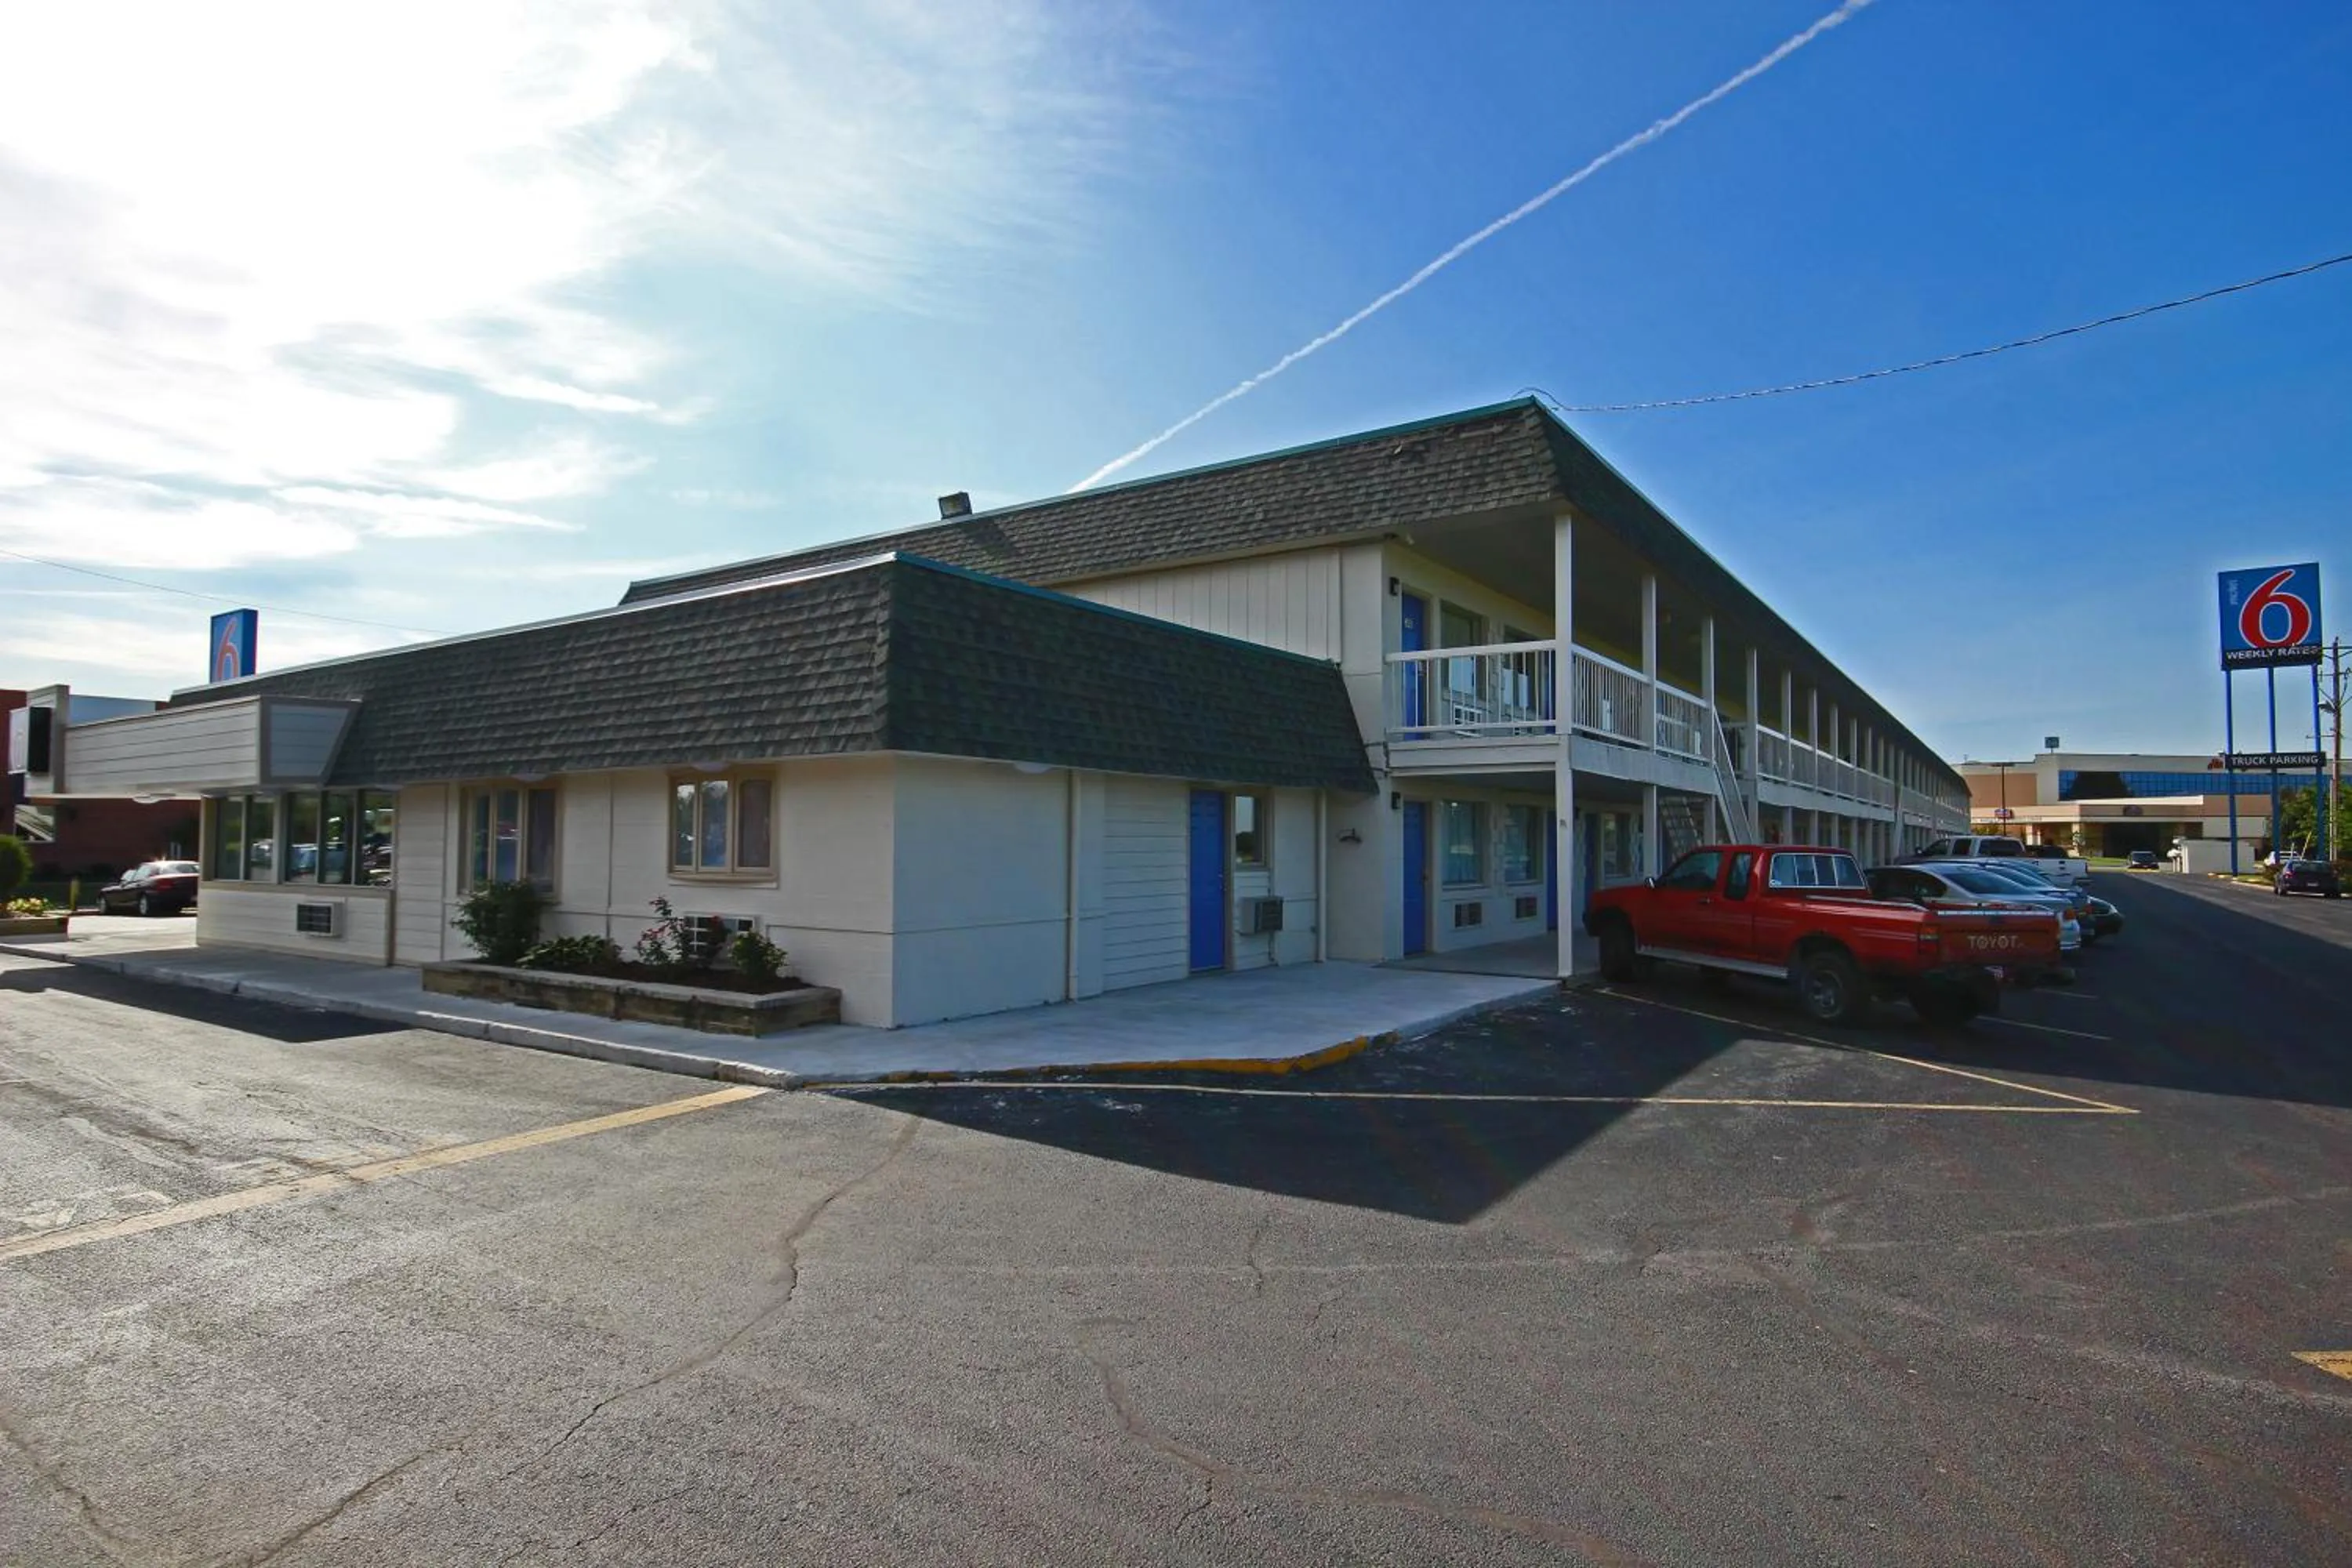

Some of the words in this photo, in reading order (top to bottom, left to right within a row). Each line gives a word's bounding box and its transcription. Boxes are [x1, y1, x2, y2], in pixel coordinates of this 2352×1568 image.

[2239, 568, 2312, 649] 6
[2227, 648, 2275, 659] WEEKLY
[2278, 644, 2319, 656] RATES
[2230, 756, 2267, 766] TRUCK
[2270, 755, 2319, 764] PARKING
[1967, 935, 2024, 949] TOYOT
